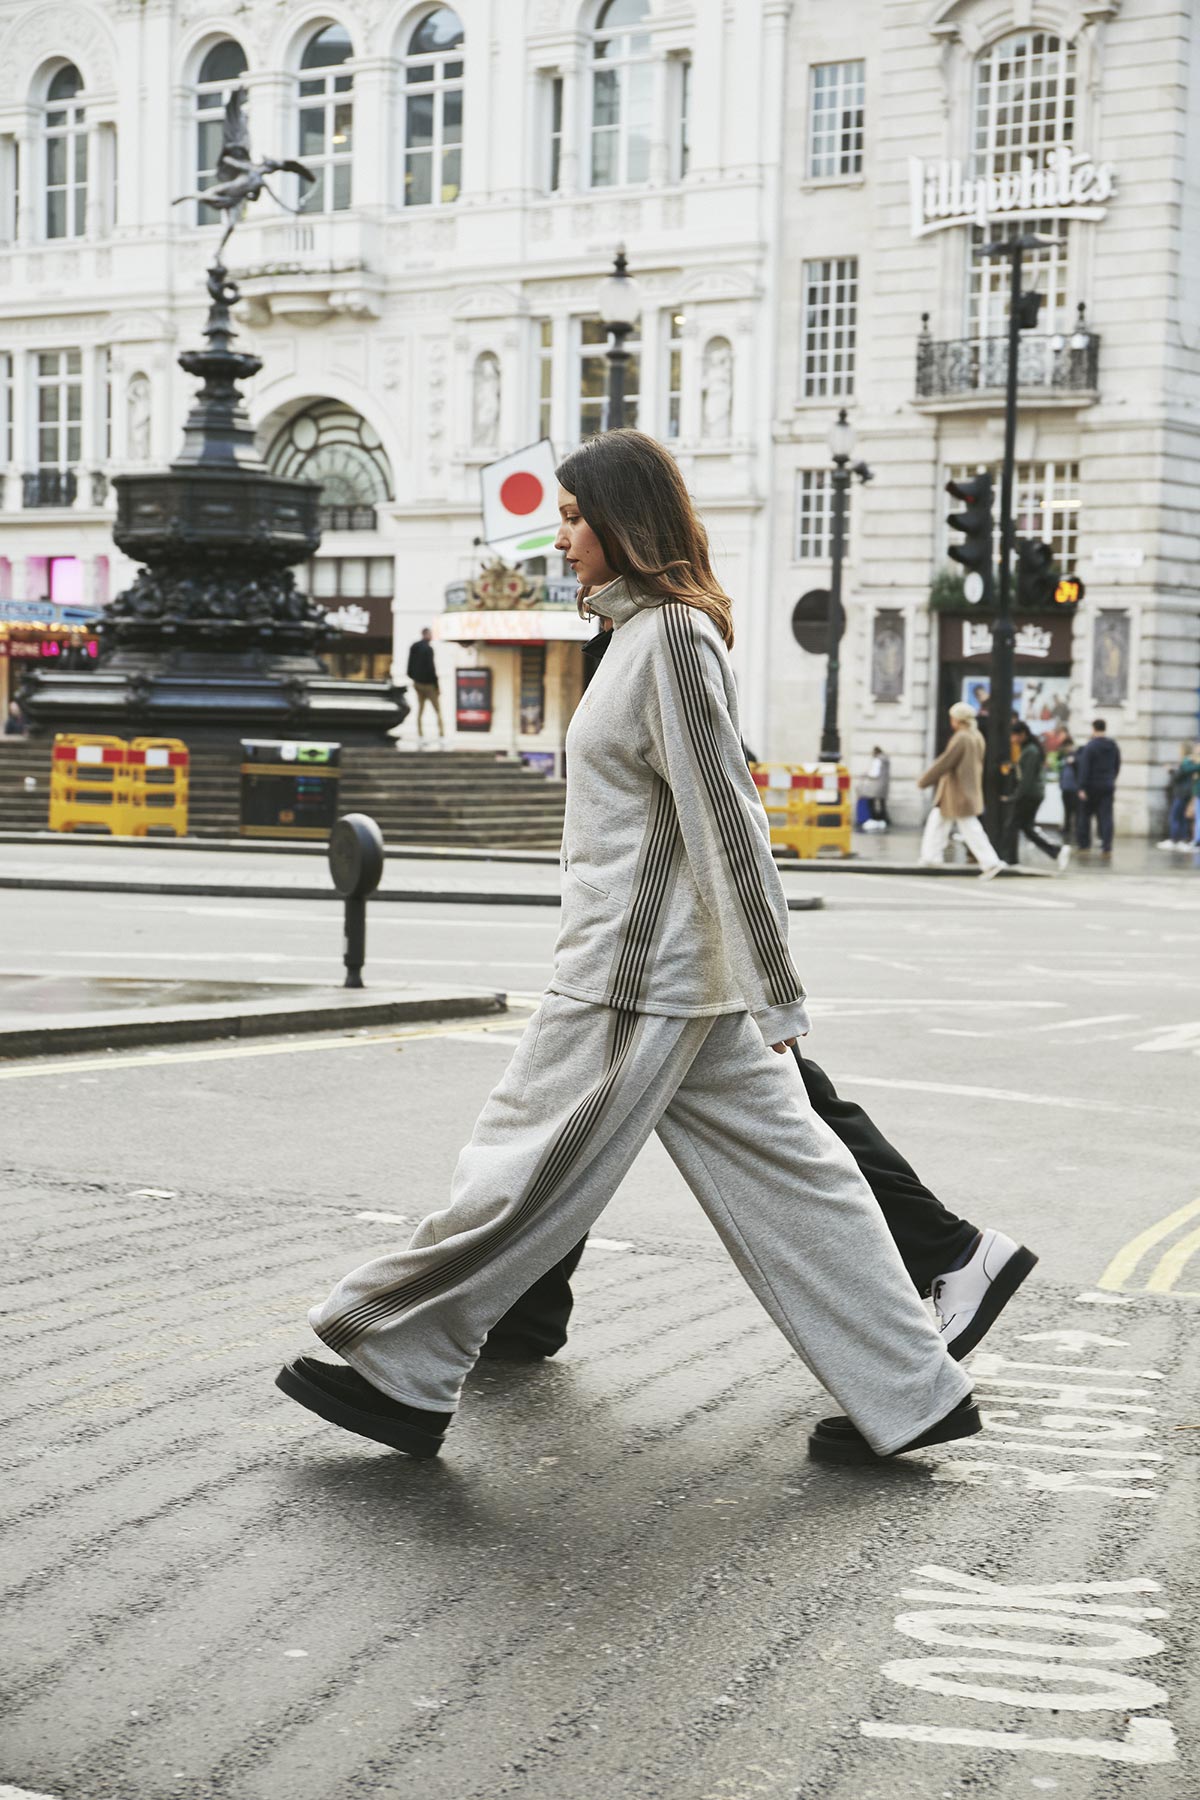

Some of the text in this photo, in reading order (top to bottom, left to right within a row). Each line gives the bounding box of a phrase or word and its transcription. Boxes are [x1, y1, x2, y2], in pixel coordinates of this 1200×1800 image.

[908, 146, 1119, 238] Lillywhites
[859, 1353, 1178, 1764] LOOK RIGHT
